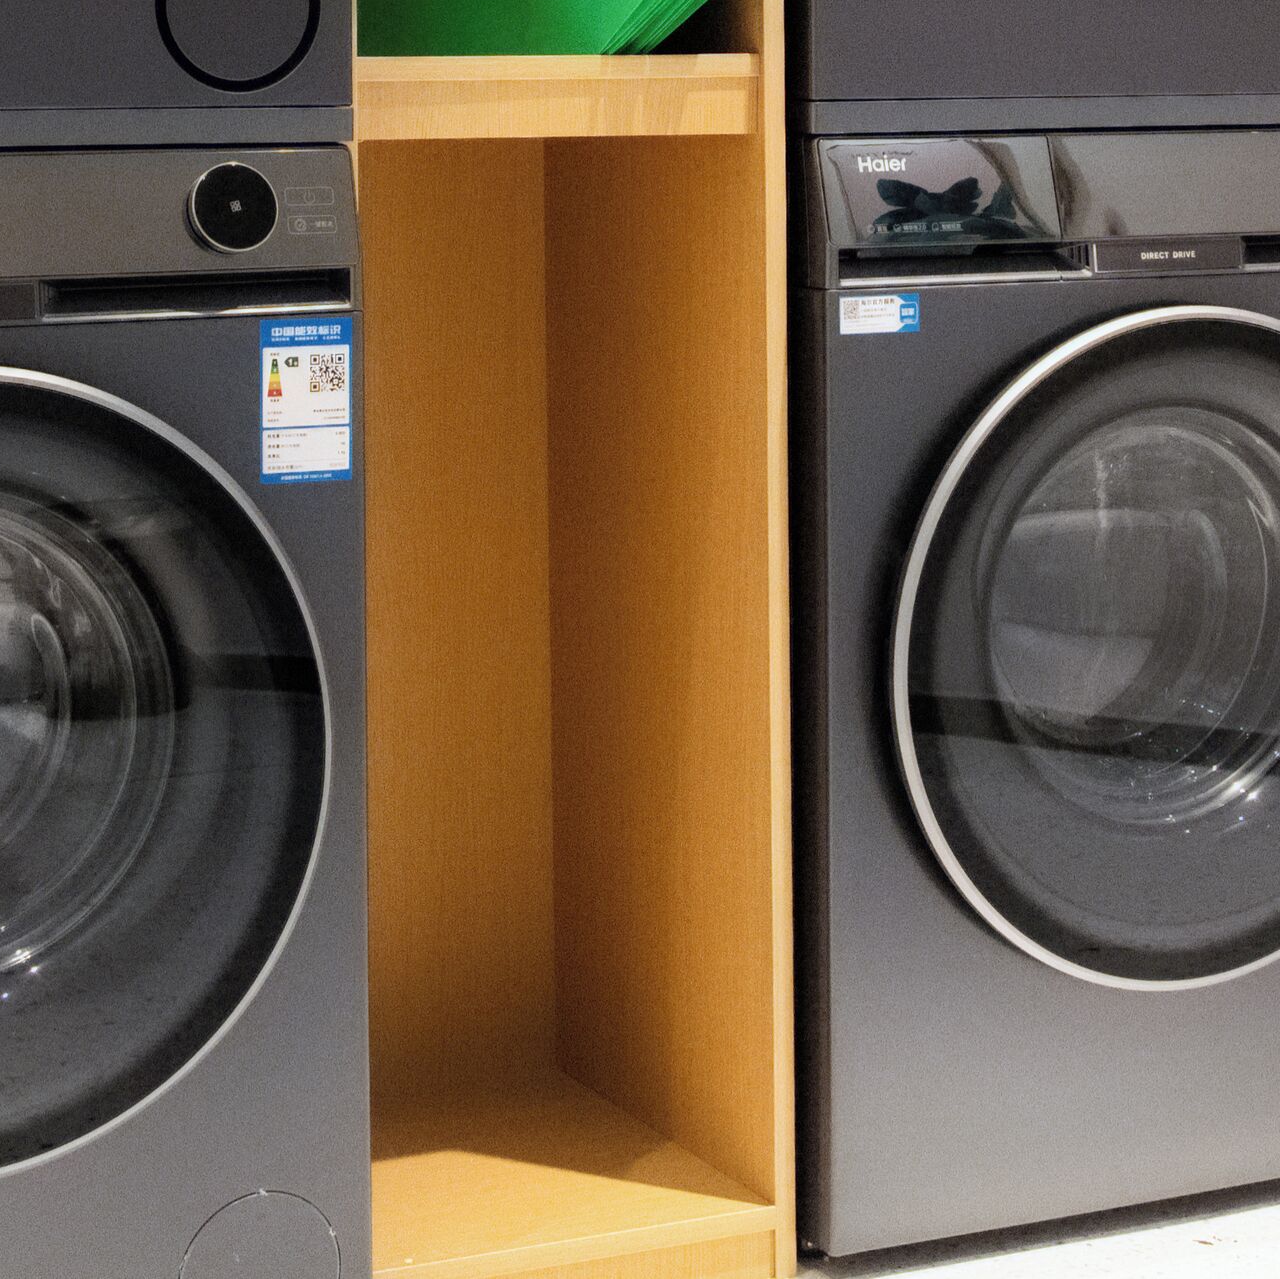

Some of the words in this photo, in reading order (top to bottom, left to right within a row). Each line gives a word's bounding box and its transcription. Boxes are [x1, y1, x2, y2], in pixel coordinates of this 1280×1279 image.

[857, 154, 907, 173] Haier
[1140, 251, 1169, 260] DIRECT
[1172, 250, 1196, 259] DRIVE
[271, 325, 341, 336] 中国能效标识
